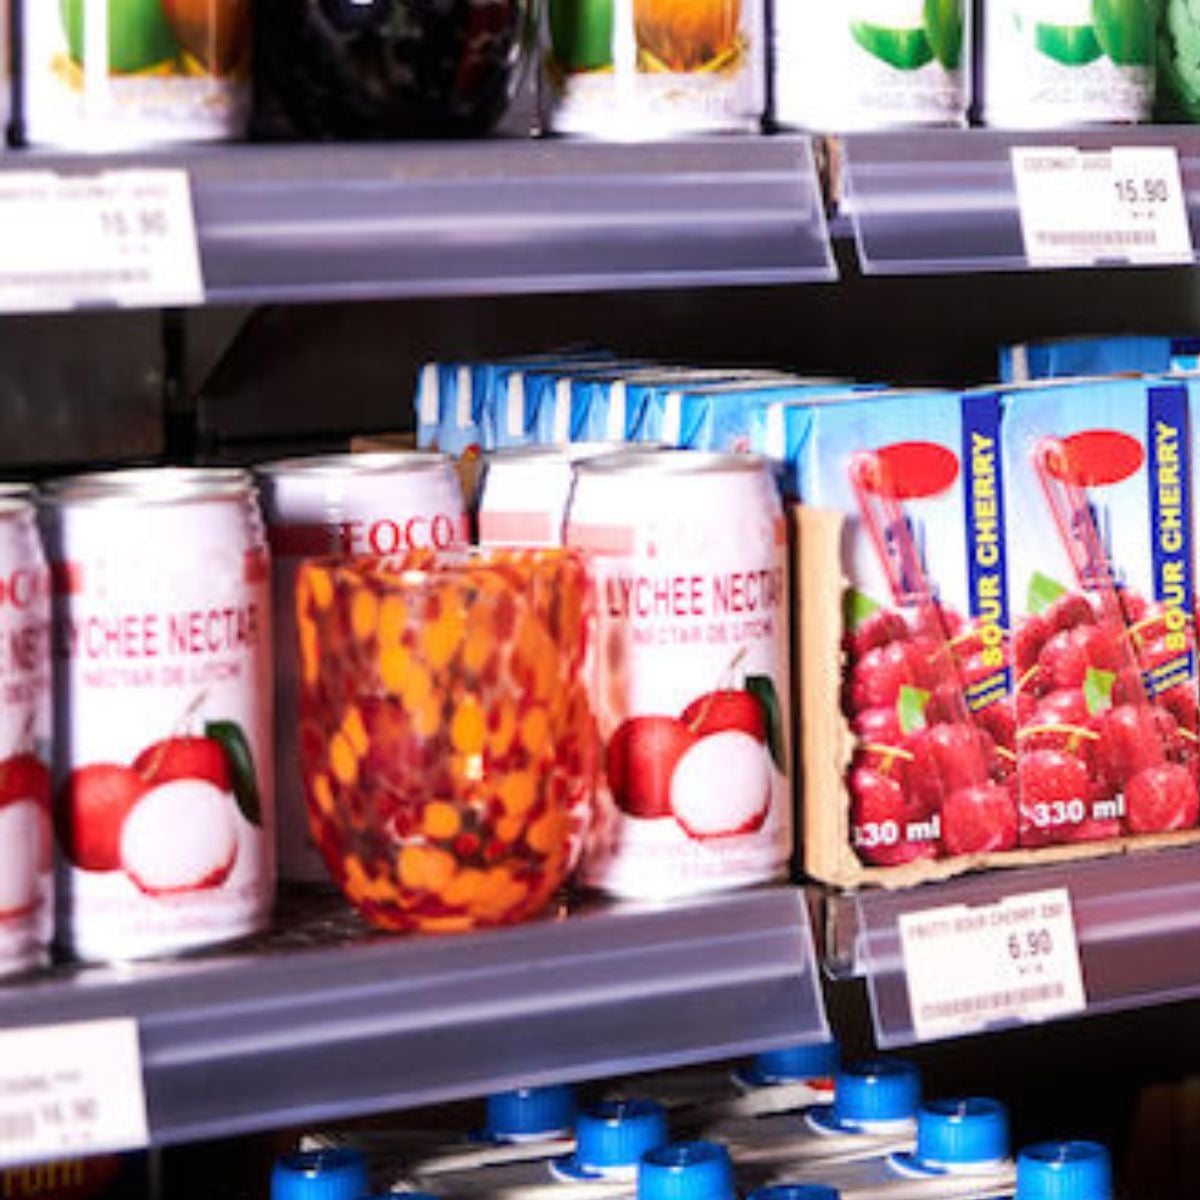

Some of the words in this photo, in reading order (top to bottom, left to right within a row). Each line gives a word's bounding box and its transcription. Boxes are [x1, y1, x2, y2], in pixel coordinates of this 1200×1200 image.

[1114, 177, 1168, 204] 15.90
[970, 431, 1000, 567] CHERRY
[1154, 419, 1185, 554] CHERRY
[605, 574, 704, 620] LYCHEE
[1160, 558, 1188, 651] SOUR
[976, 574, 1005, 668] SOUR
[906, 815, 942, 841] ml
[1033, 799, 1084, 827] 330
[1092, 794, 1125, 818] ml
[1007, 927, 1054, 960] 6.90
